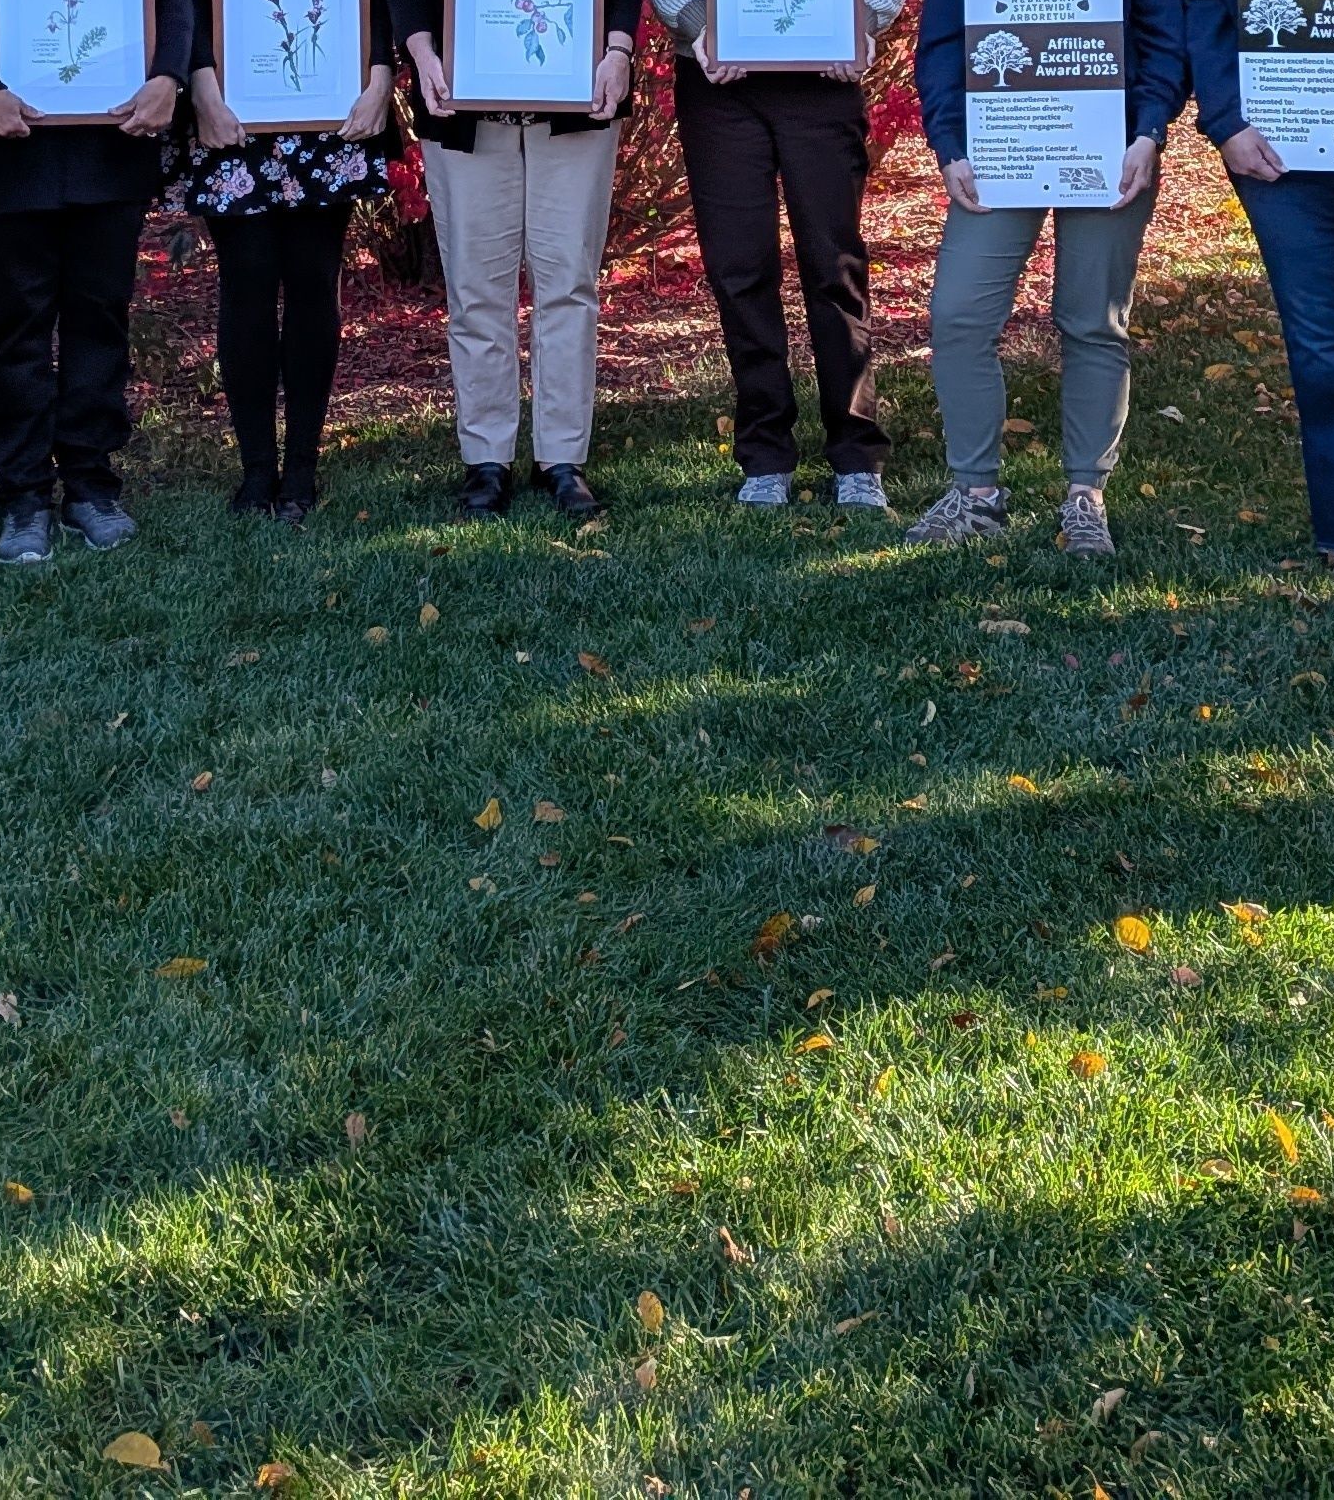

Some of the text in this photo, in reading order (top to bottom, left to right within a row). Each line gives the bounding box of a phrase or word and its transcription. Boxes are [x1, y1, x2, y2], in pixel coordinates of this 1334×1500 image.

[1014, 3, 1071, 12] STATEWIDE
[1009, 13, 1075, 21] ARBORETUM
[1047, 37, 1106, 50] Affiliate
[1040, 51, 1115, 63] Excellence
[1245, 57, 1285, 65] Recognizes
[1035, 64, 1119, 76] Award 2025
[1259, 85, 1302, 93] Community
[1246, 98, 1283, 106] Presented
[1042, 105, 1074, 113] diversity
[1032, 114, 1061, 122] practice
[1029, 123, 1073, 131] engagement
